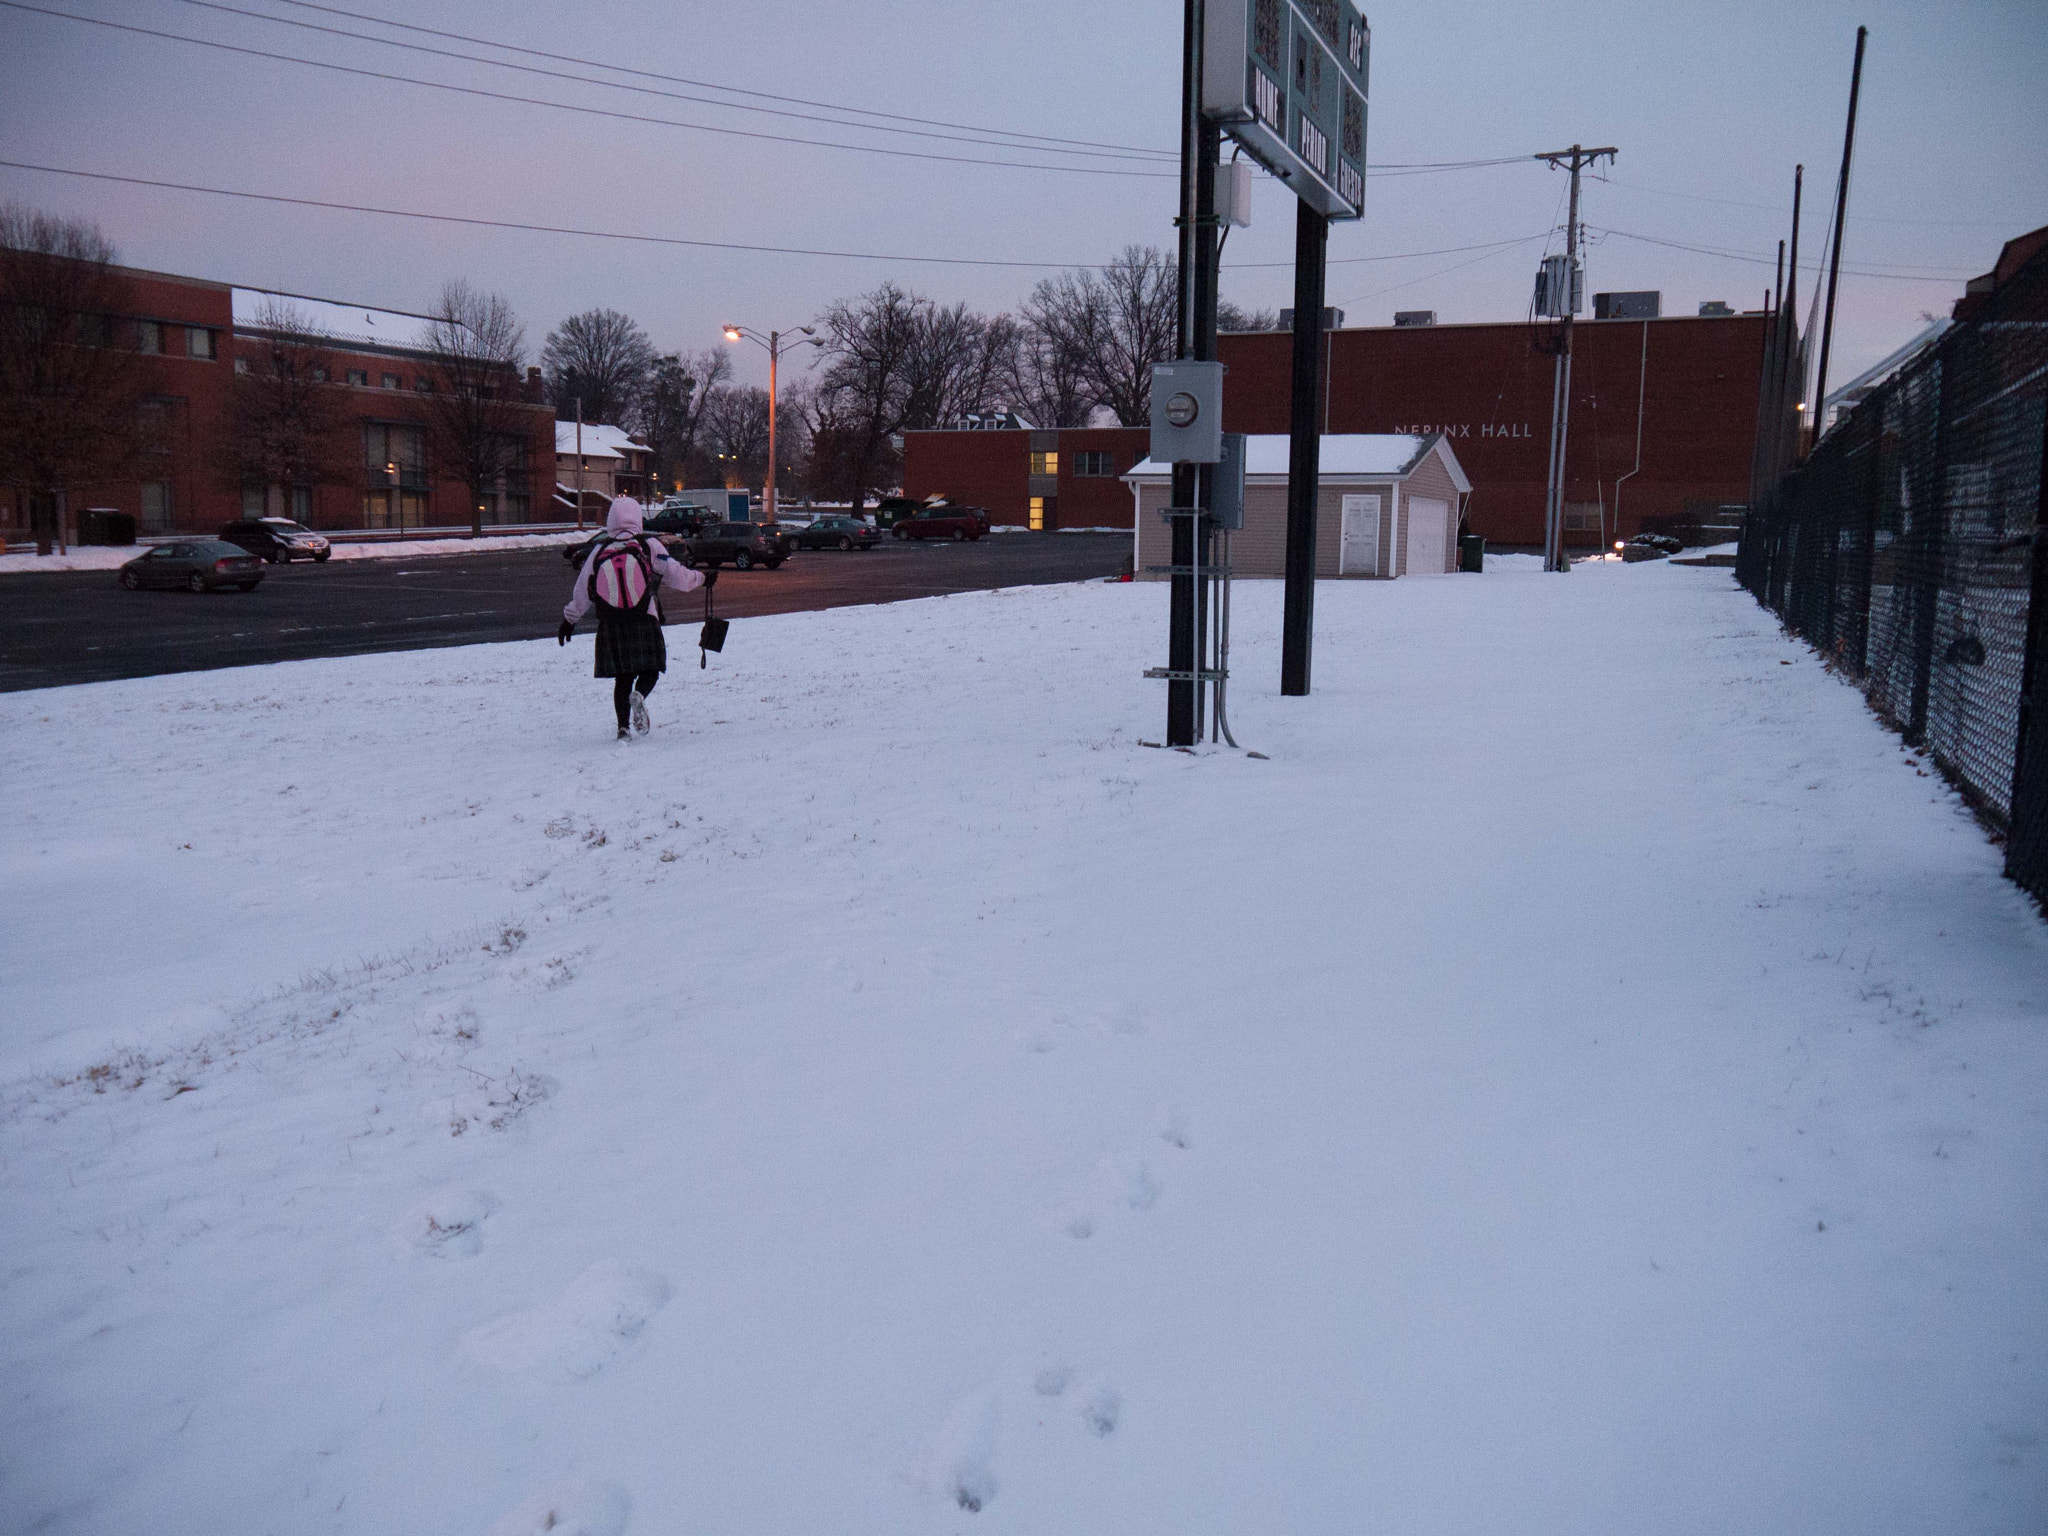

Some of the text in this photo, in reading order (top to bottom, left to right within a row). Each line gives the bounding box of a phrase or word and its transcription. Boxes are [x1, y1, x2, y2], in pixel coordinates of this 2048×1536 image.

[1256, 67, 1278, 130] HOME
[1302, 115, 1326, 175] PERIOD
[1340, 157, 1361, 206] GUESTS
[1395, 424, 1532, 437] NERINX HALL
